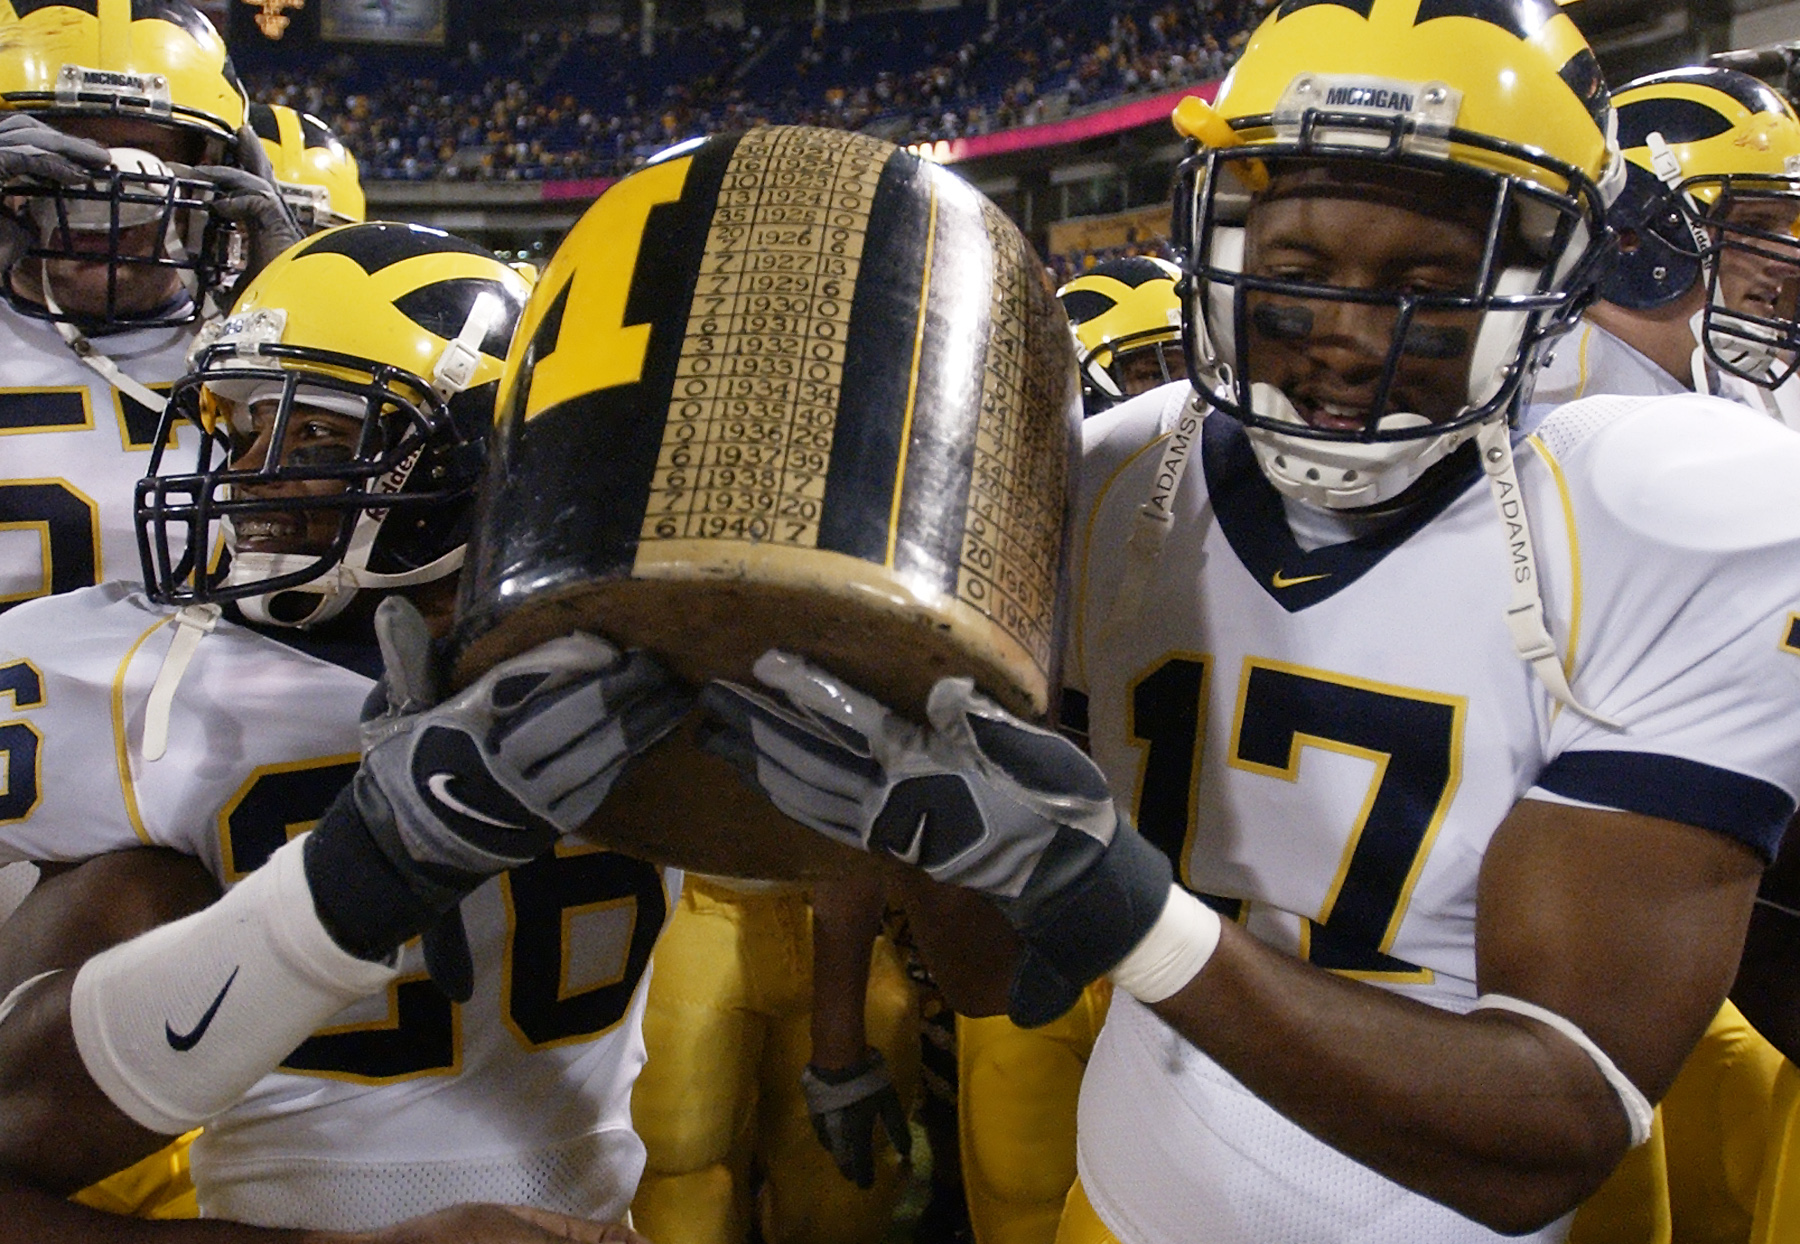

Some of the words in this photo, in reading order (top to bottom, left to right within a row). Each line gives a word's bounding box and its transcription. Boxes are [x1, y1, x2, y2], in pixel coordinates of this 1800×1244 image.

[1326, 87, 1415, 112] MICHIGAN
[734, 158, 761, 173] 16
[730, 172, 759, 189] 10
[841, 180, 863, 194] 0
[726, 190, 751, 205] 13
[767, 190, 823, 206] 1924
[840, 196, 861, 211] 0
[716, 208, 747, 224] 35
[761, 208, 818, 224] 1925
[833, 214, 855, 228] 0
[715, 227, 746, 240] 20
[756, 229, 812, 247] 1926
[714, 255, 735, 271] 7
[752, 254, 814, 270] 1927
[822, 258, 847, 276] 13
[709, 276, 730, 293] 7
[749, 275, 810, 292] 1929
[821, 280, 841, 298] 6
[706, 297, 728, 314] 7
[743, 297, 809, 314] 1930
[817, 300, 840, 318] 0
[700, 317, 718, 333] 6
[739, 316, 800, 335] 1931
[815, 321, 836, 340] 0
[698, 337, 715, 352] 3
[735, 336, 799, 356] 1932
[812, 342, 834, 361] 0
[690, 356, 711, 374] 0
[730, 357, 794, 376] 1933
[808, 362, 830, 382] 0
[684, 378, 708, 398] 0
[726, 378, 791, 400] 1934
[803, 381, 835, 404] 34
[995, 380, 1008, 401] 0
[679, 400, 702, 420] 0
[721, 400, 787, 421] 1935
[800, 407, 833, 428] 40
[676, 423, 696, 443] 0
[719, 422, 784, 444] 1936
[794, 427, 830, 449] 26
[670, 445, 691, 468] 6
[714, 444, 782, 469] 1937
[790, 451, 824, 472] 39
[979, 455, 1002, 479] 24
[1152, 416, 1197, 512] ADAMS
[666, 469, 687, 489] 6
[706, 469, 776, 490] 1938
[793, 475, 814, 494] 7
[979, 472, 1001, 499] 20
[664, 492, 684, 512] 7
[702, 492, 774, 514] 1939
[780, 499, 817, 522] 20
[654, 517, 678, 539] 6
[698, 516, 769, 540] 1940
[785, 522, 808, 542] 7
[972, 517, 987, 537] 0
[1496, 479, 1531, 584] ADAMS
[966, 539, 993, 571] 20
[966, 578, 986, 601] 0
[1126, 650, 1468, 985] 17
